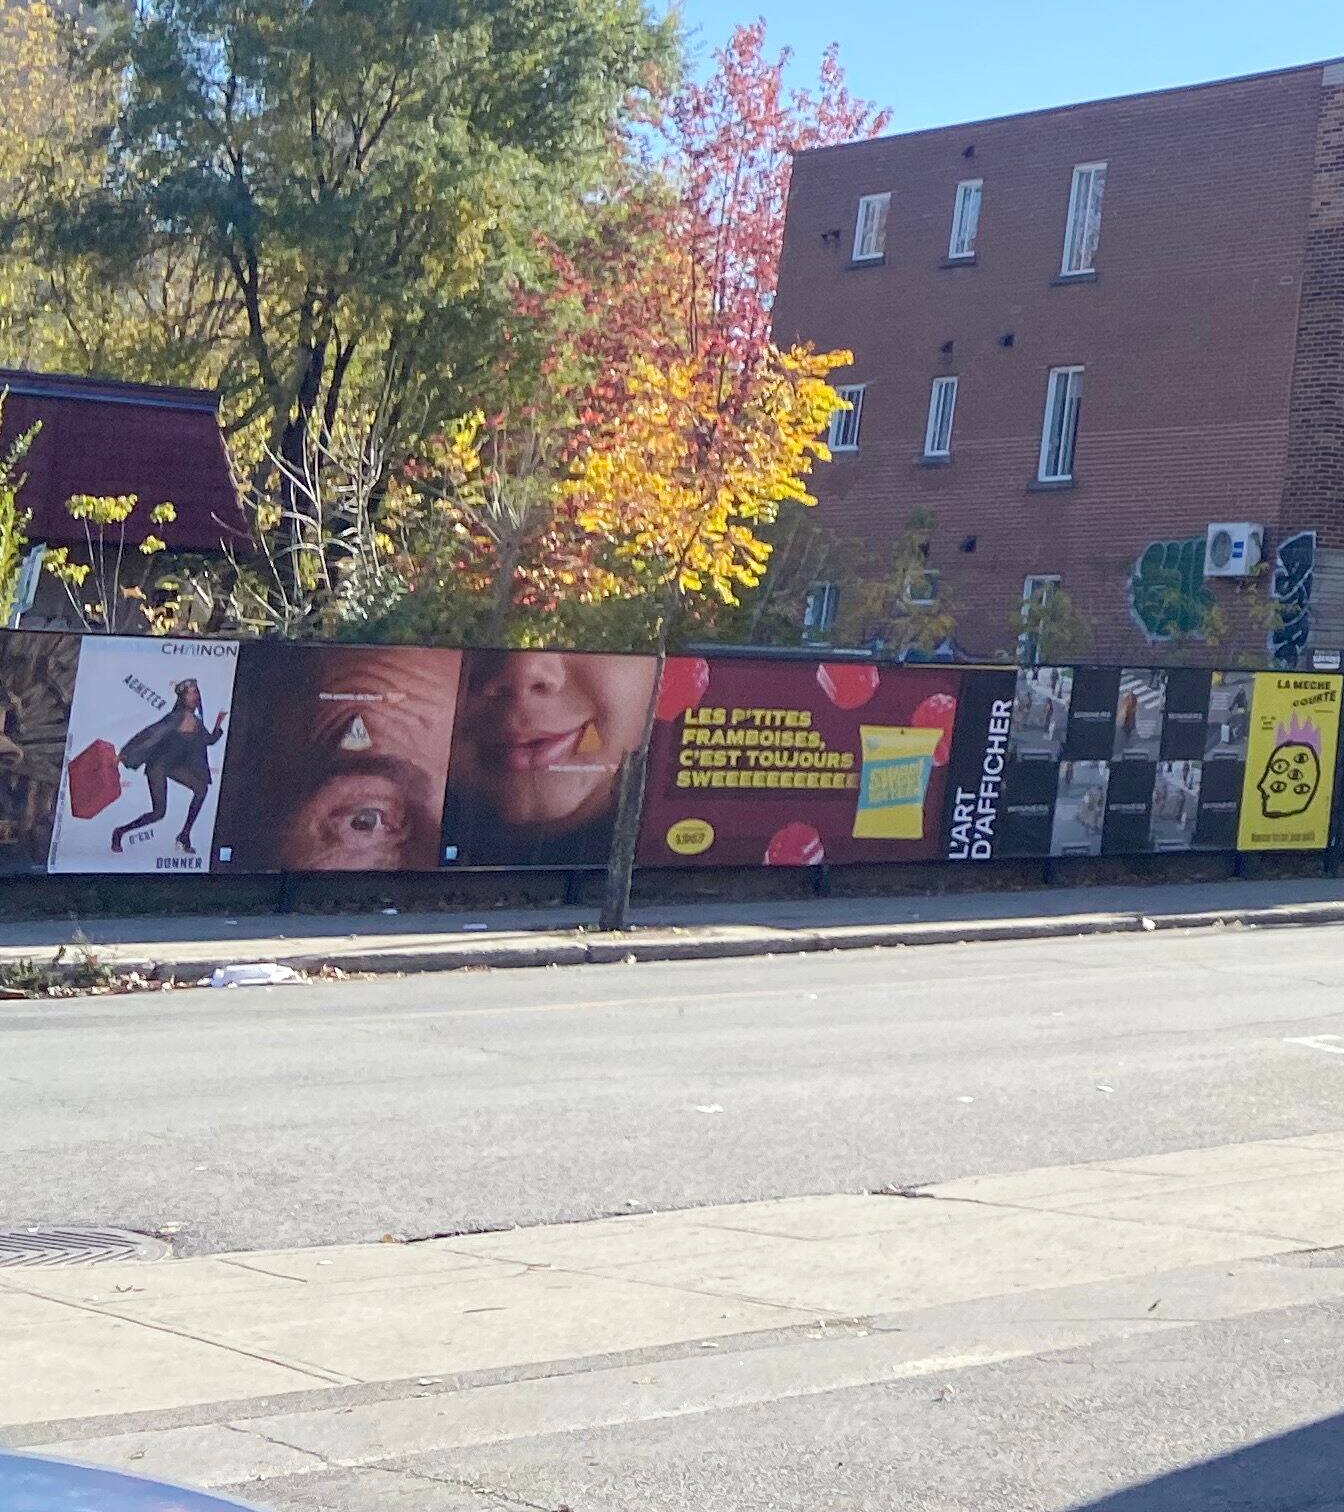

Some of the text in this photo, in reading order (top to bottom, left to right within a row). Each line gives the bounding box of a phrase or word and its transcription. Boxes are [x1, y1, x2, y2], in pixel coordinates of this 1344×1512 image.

[1277, 679, 1291, 690] LA
[684, 707, 812, 728] LES P'TITES
[681, 727, 826, 750] FRAMBOISES,
[679, 749, 854, 769] C'EST TOUJOURS
[970, 699, 1014, 861] D'AFFICHER
[949, 786, 977, 861] L'ART
[156, 857, 203, 870] DONNER
